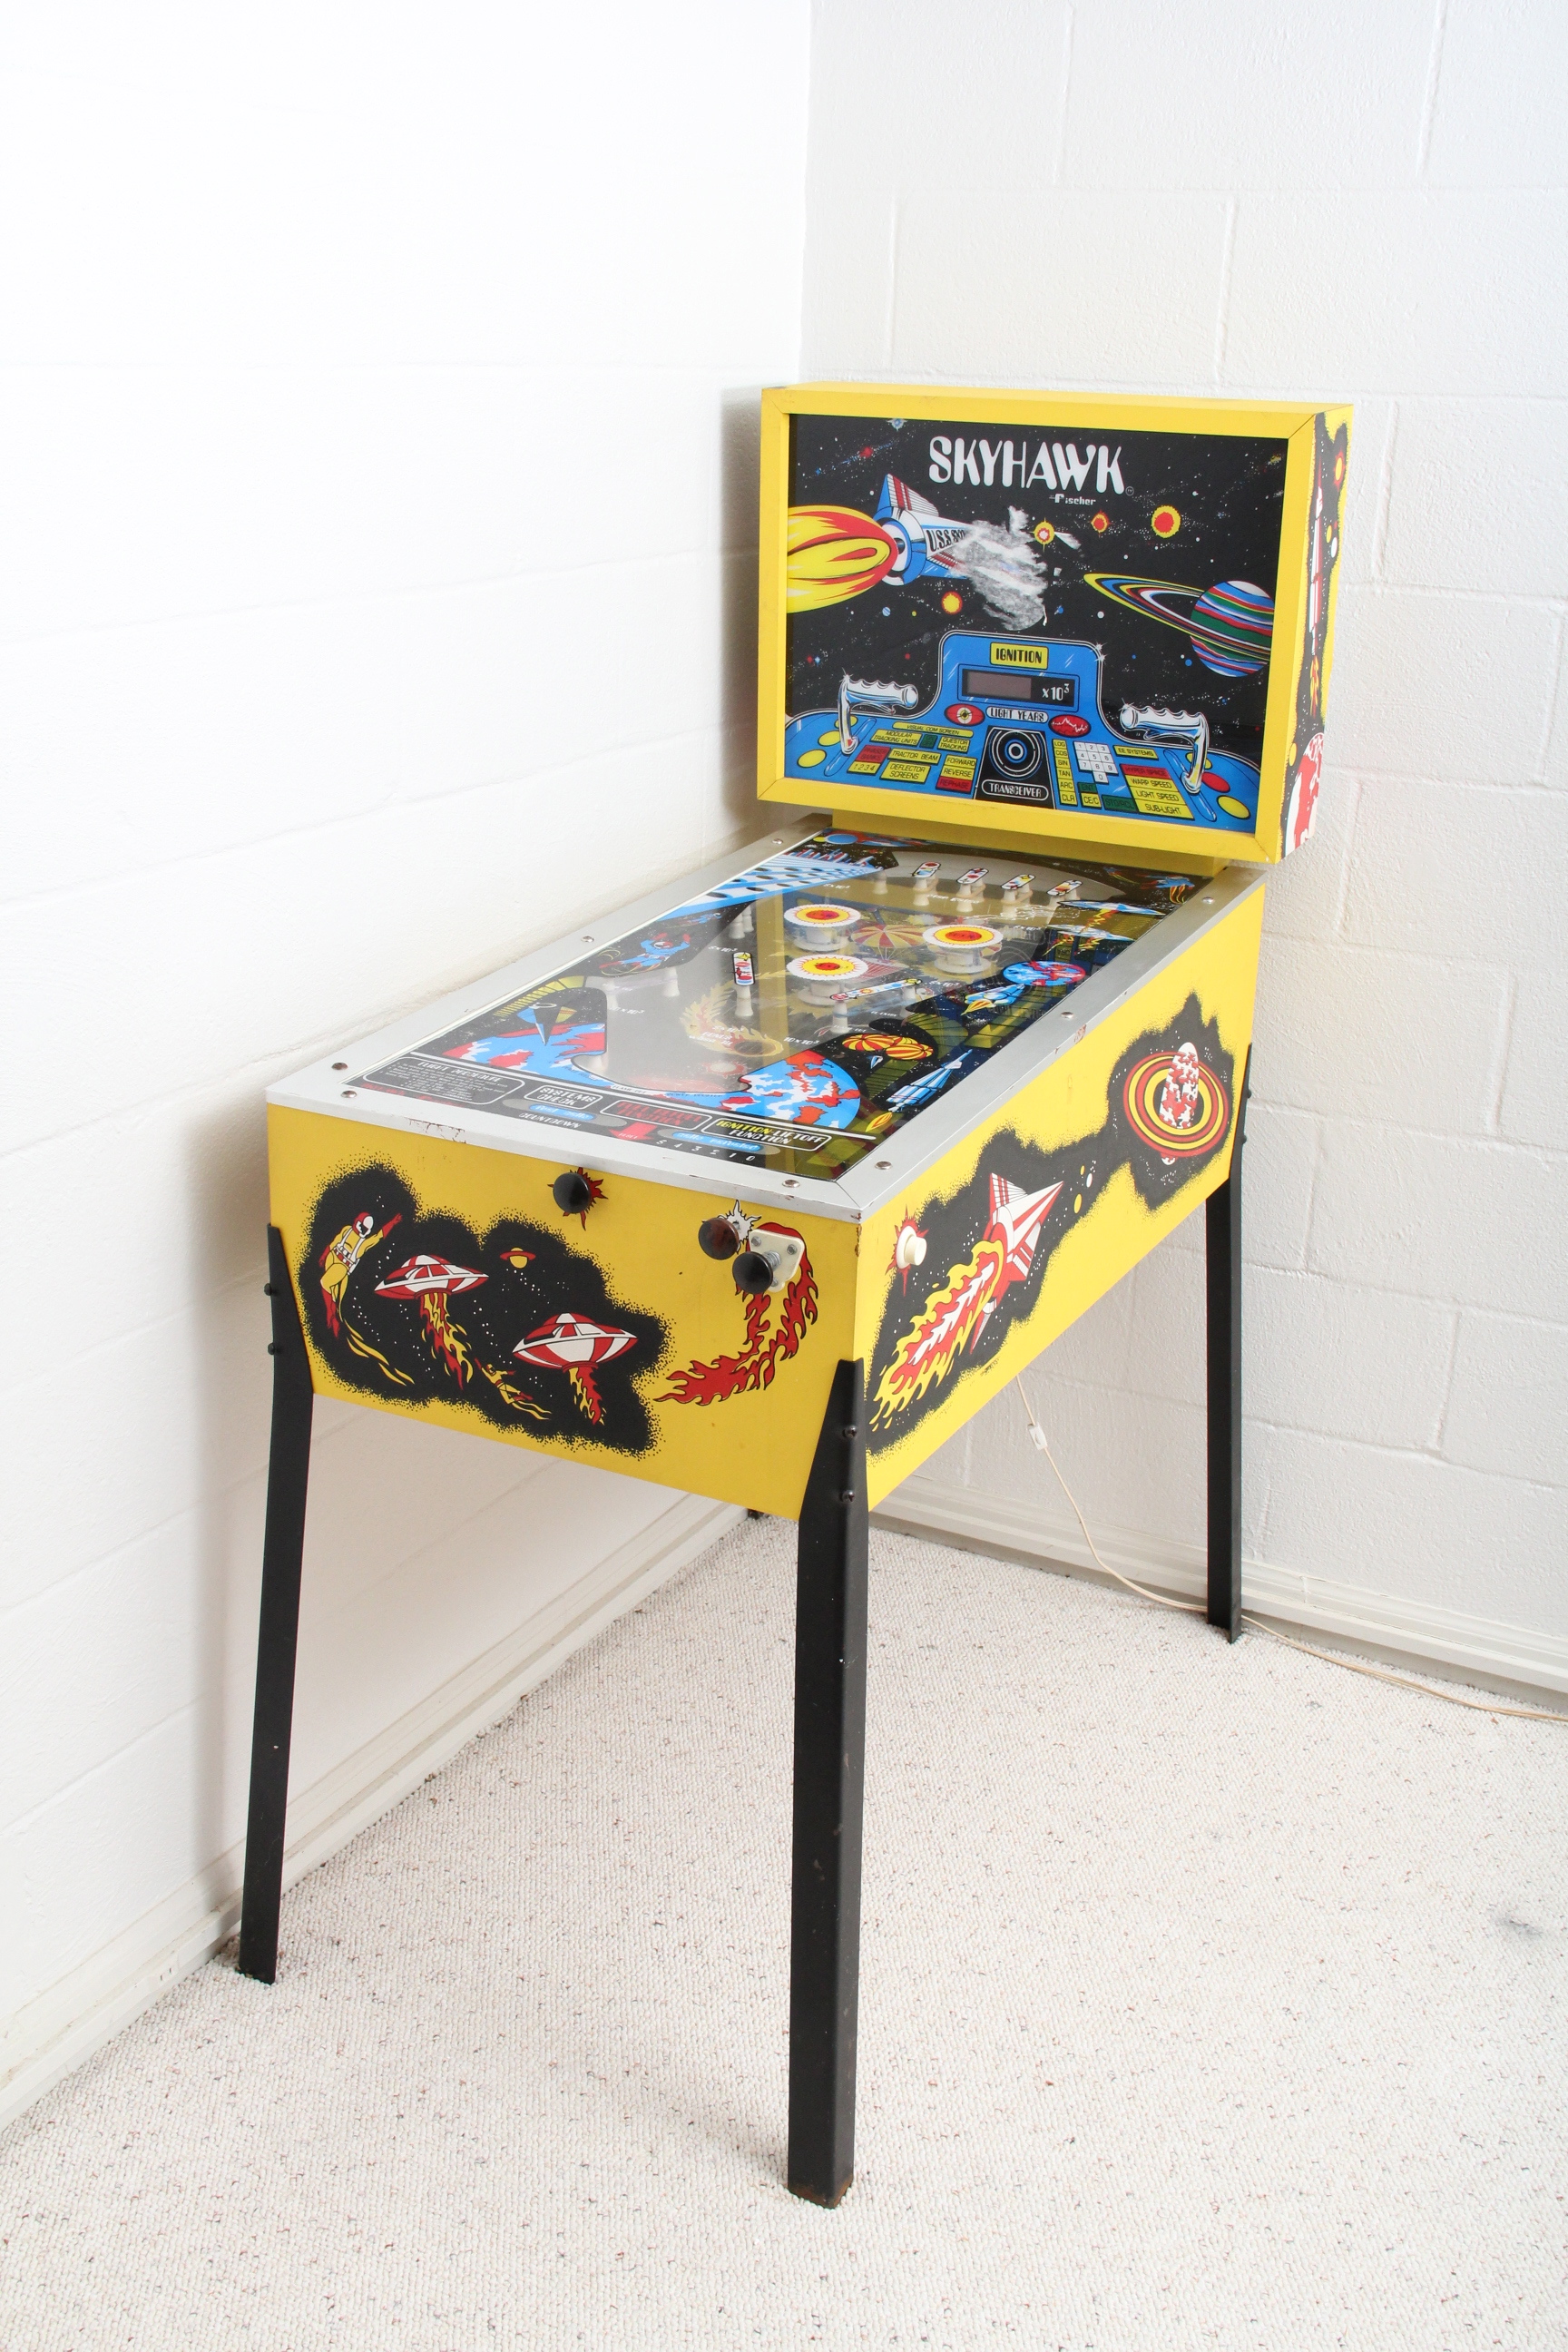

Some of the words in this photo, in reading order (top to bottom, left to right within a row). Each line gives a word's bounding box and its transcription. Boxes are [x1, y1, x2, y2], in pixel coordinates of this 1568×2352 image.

[928, 436, 1124, 495] SKYHAWK
[995, 648, 1043, 663] IGNITION
[990, 708, 1013, 719] LIGHT
[1017, 710, 1044, 721] YEARS
[873, 735, 899, 743] TRACKING
[942, 737, 968, 745] QUESTOR
[940, 742, 967, 751] TRACKING
[893, 750, 918, 759] TRACTOR
[920, 753, 939, 761] BEAM
[1126, 749, 1154, 757] SYSTEMS
[889, 763, 926, 772] DEFLECTOR
[946, 757, 976, 767] FORWARD
[889, 770, 919, 779] SCREENS
[943, 768, 972, 777] REVERSE
[1132, 778, 1150, 786] WARP
[1150, 780, 1172, 789] SPEED
[989, 782, 1042, 798] TRANSCEIVER
[1135, 790, 1155, 799] LIGHT
[1156, 792, 1180, 801] SPEED
[1062, 793, 1075, 802] CLR
[1083, 796, 1100, 805] CE/C
[1145, 803, 1181, 815] SUB-LIGHT
[537, 1093, 576, 1106] CHECK
[540, 1087, 596, 1102] SYSTEMS
[518, 1112, 582, 1129] COUNTDOWN
[715, 1119, 827, 1143] IGNITION-LIFTOFF
[729, 1129, 792, 1144] FUNCTION
